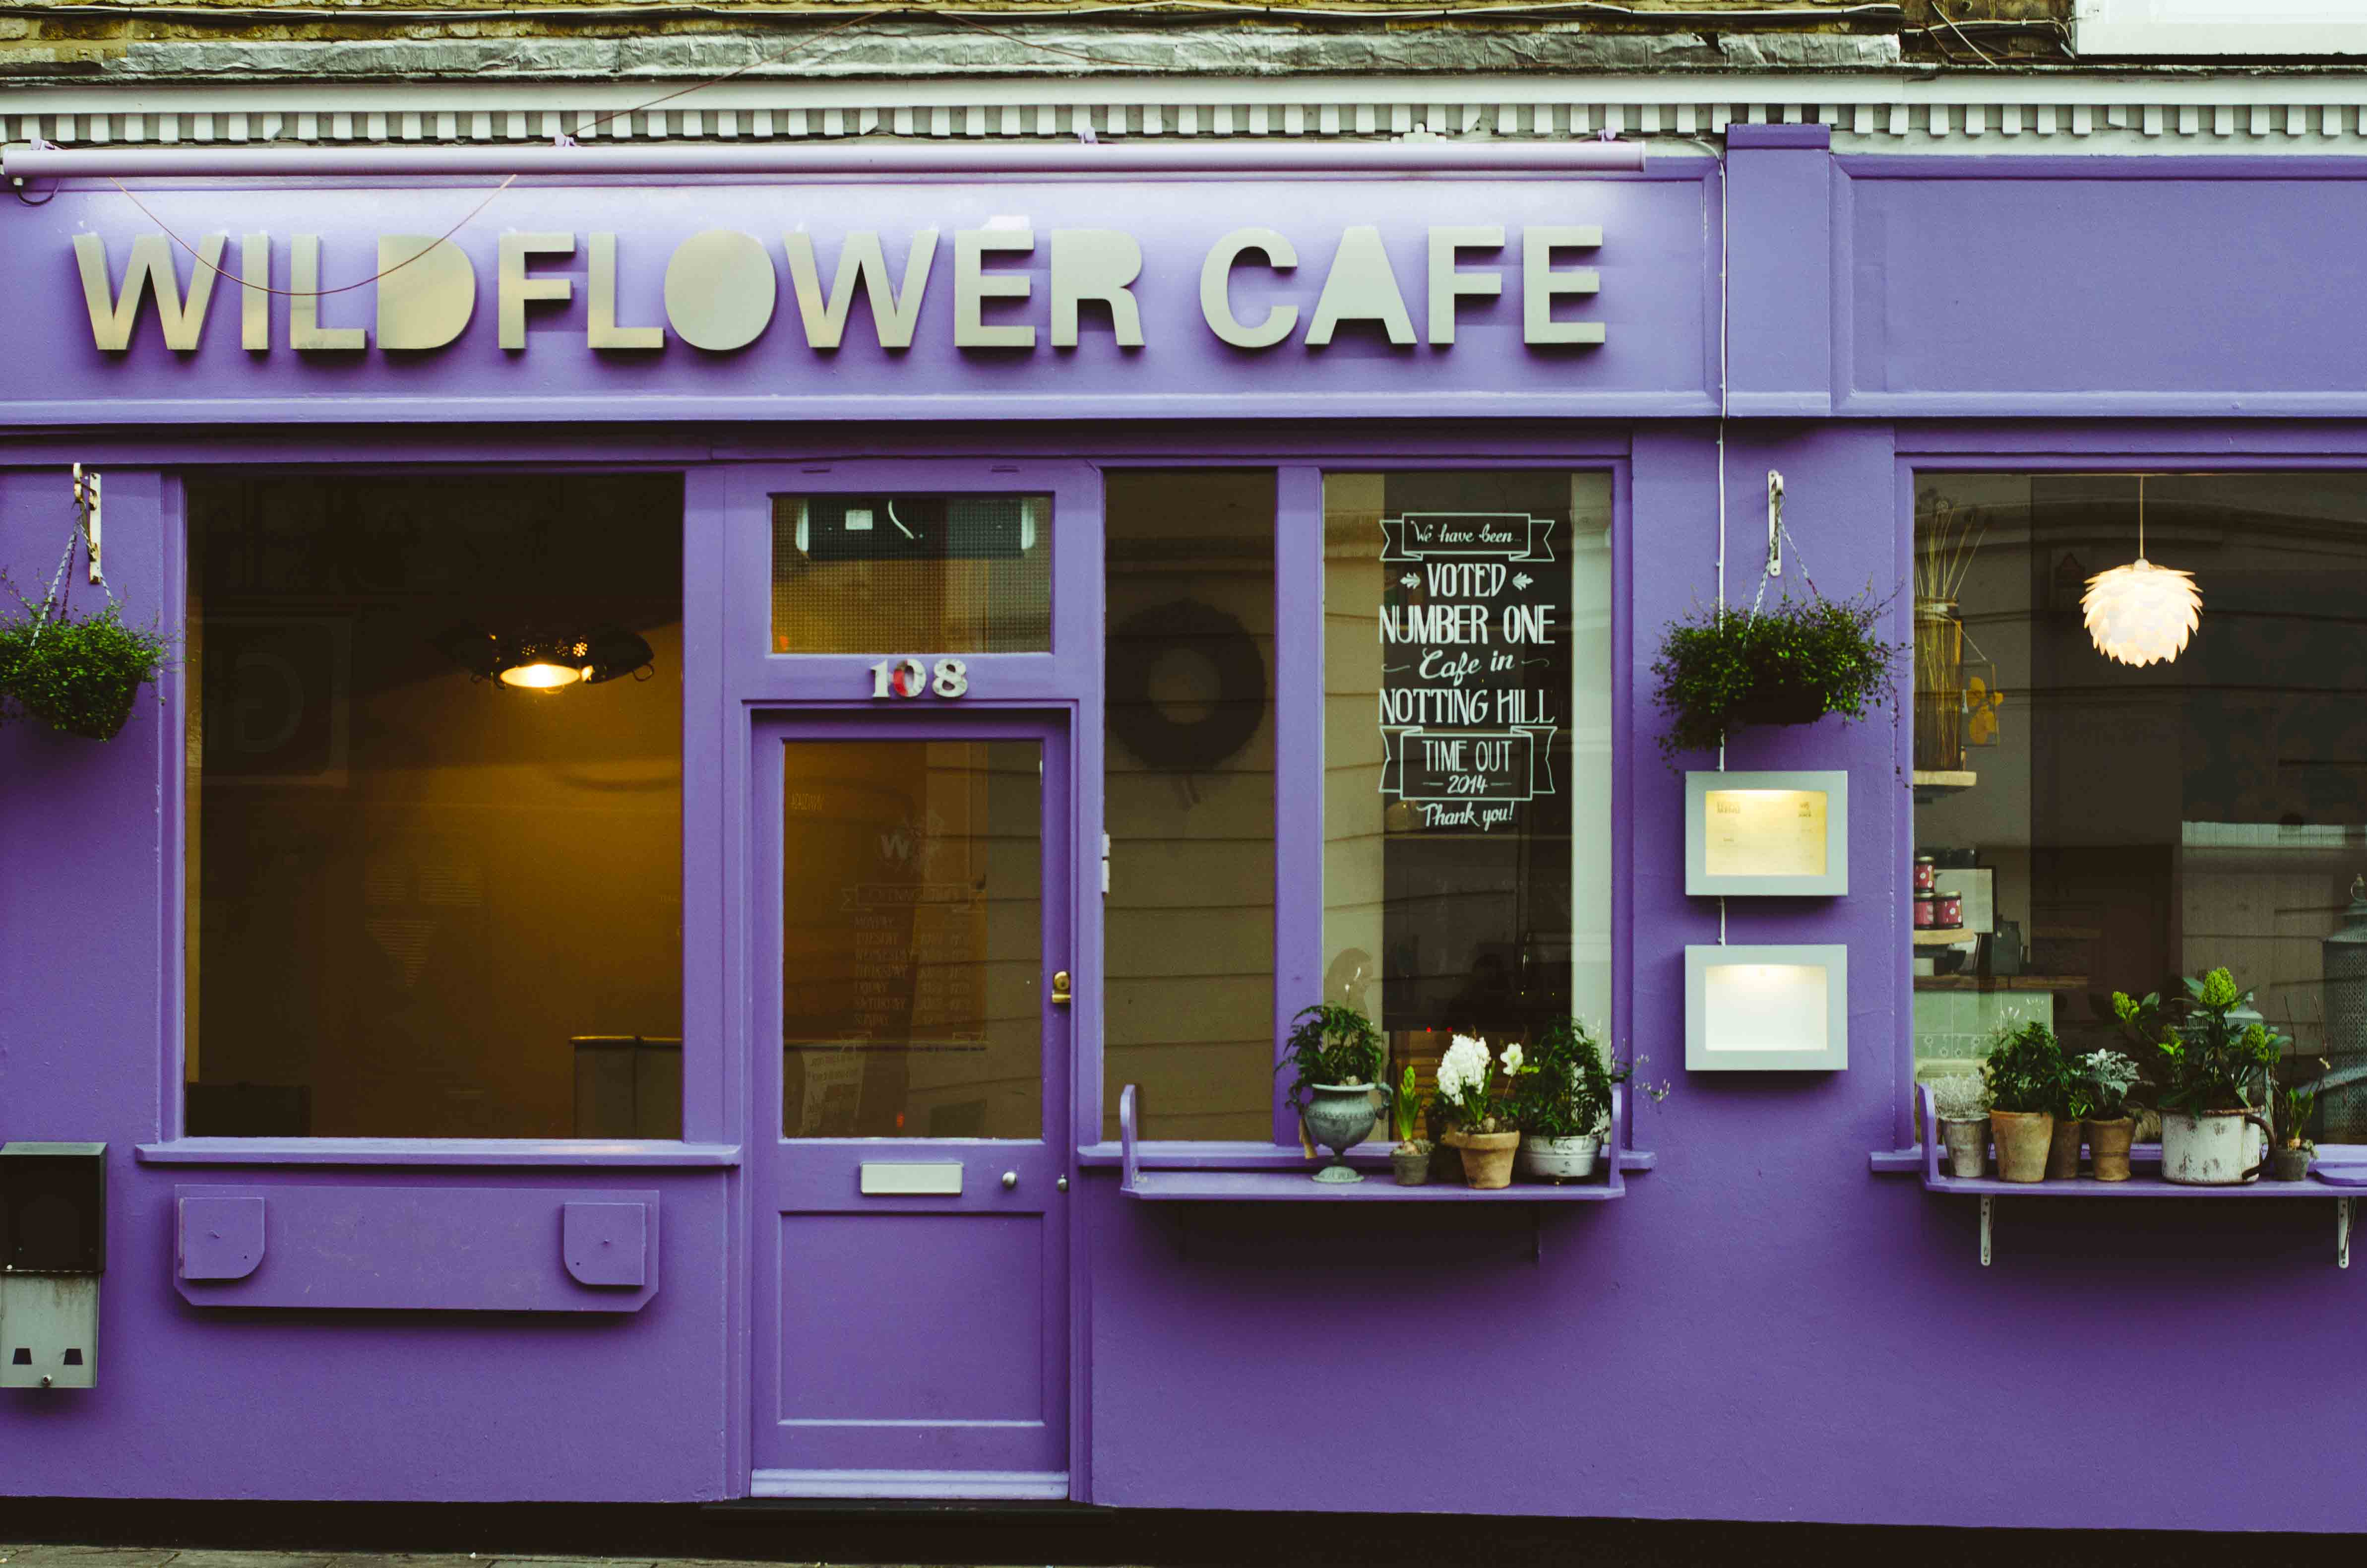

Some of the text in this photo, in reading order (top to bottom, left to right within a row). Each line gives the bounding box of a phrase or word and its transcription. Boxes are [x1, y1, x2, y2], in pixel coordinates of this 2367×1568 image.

[72, 226, 1606, 351] WILDFLOWER CAFE
[1410, 520, 1433, 543] We
[1437, 523, 1474, 543] have
[1426, 563, 1507, 597] VOTED
[1379, 605, 1556, 644] NUMBER ONE
[871, 658, 968, 698] 108
[1419, 647, 1515, 687] Cafe in
[1378, 688, 1556, 725] NOTTING HILL
[1422, 740, 1513, 772] TIME OUT
[1447, 774, 1488, 794] 2014
[1416, 801, 1515, 832] Thank you!
